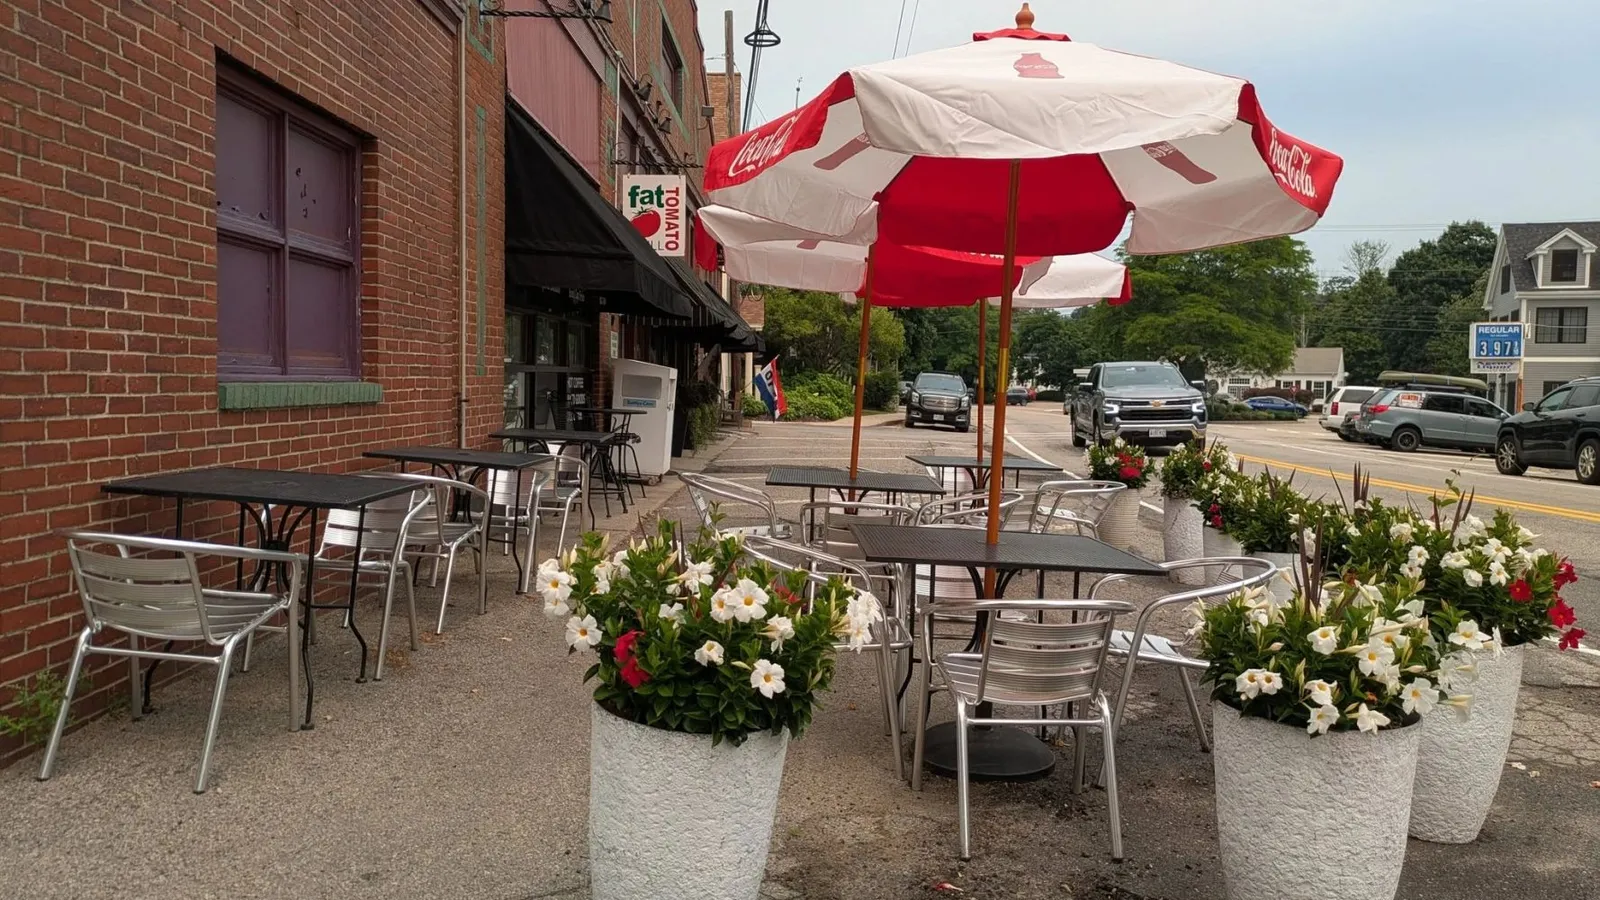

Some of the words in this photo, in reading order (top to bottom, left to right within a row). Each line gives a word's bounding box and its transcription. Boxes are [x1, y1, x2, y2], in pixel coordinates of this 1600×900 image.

[628, 184, 664, 208] fat
[665, 187, 680, 251] TOMATO
[1478, 326, 1520, 334] REGULAR
